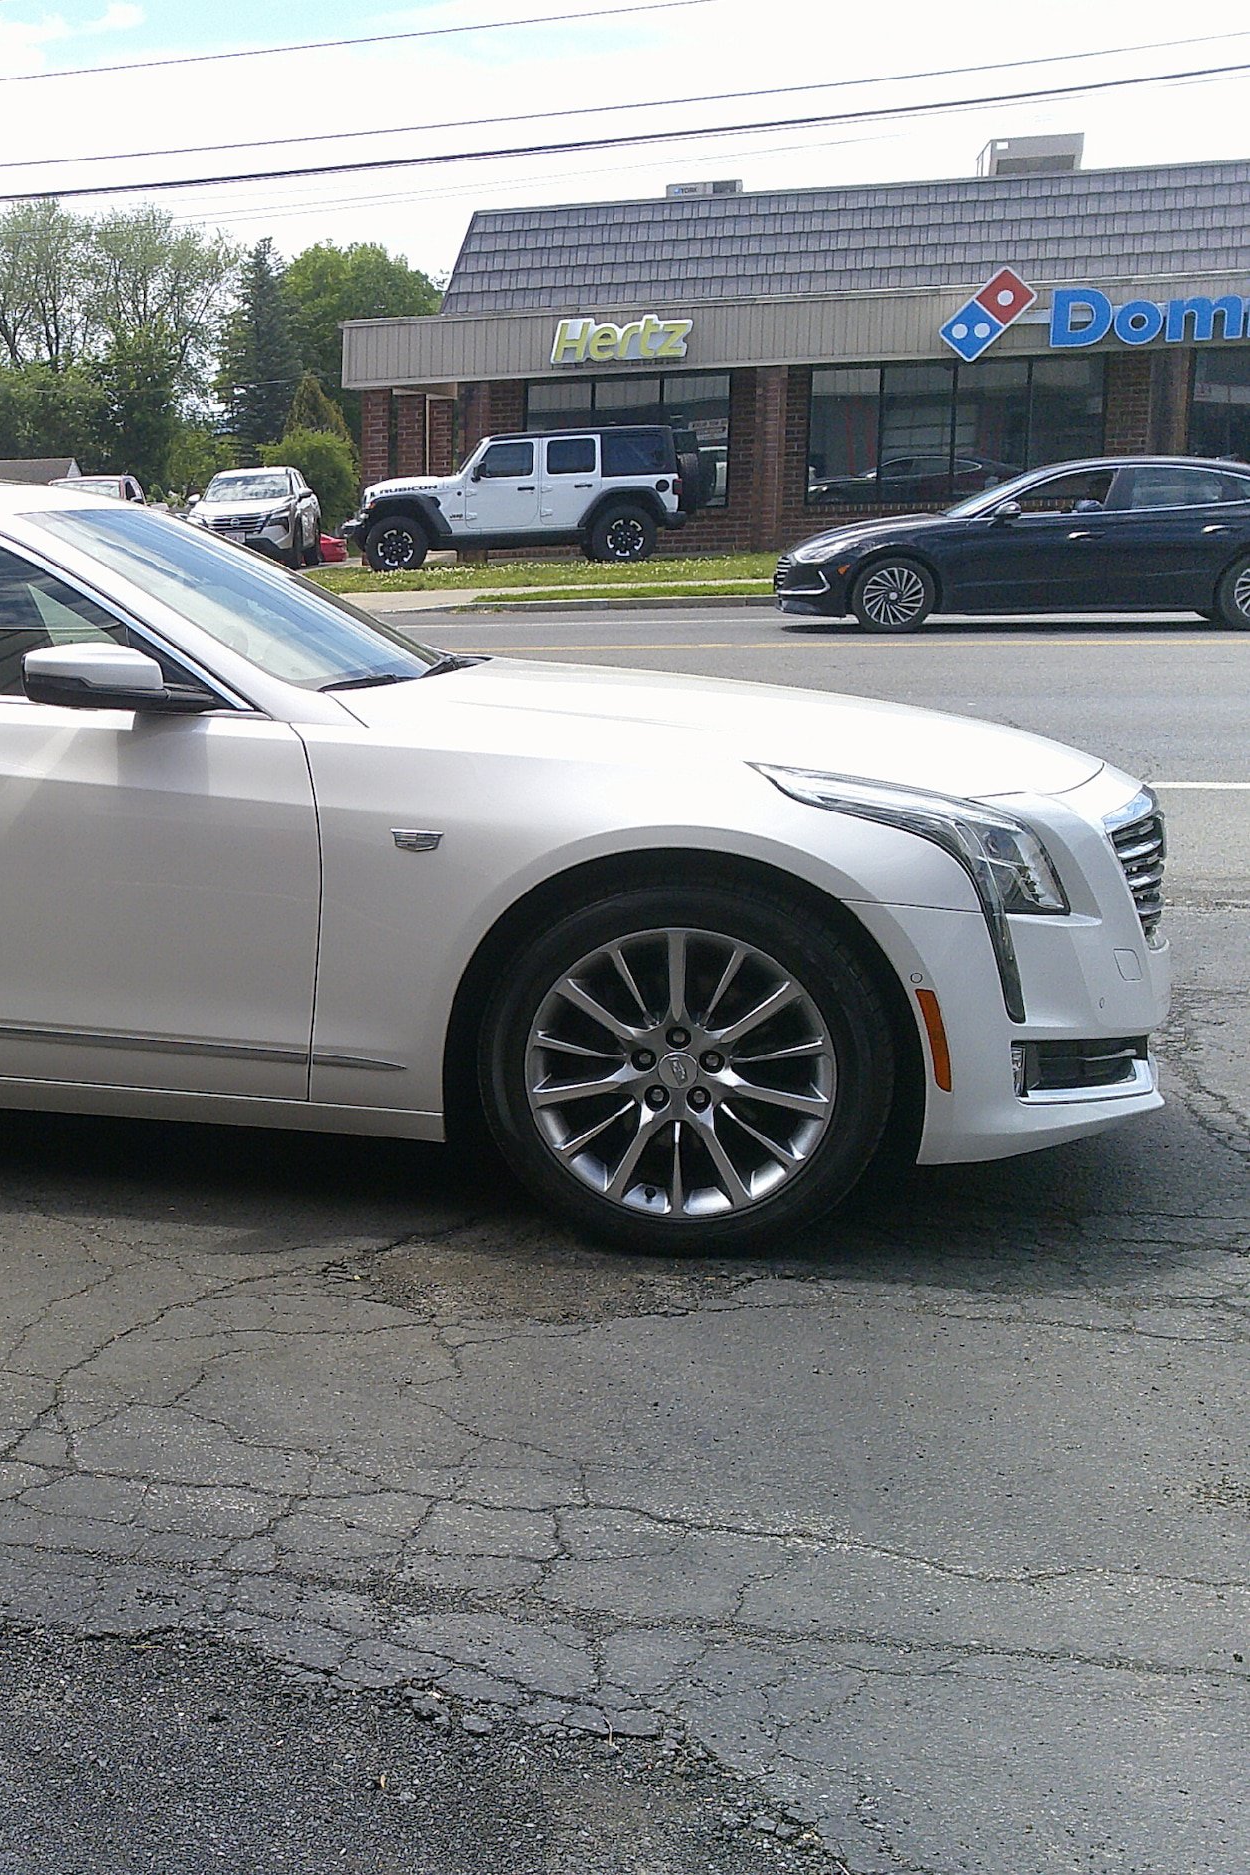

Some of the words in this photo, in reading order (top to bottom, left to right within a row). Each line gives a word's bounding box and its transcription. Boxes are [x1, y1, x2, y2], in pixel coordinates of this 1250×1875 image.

[553, 317, 688, 362] Hertz
[1050, 288, 1250, 348] Dom
[380, 485, 438, 494] RUBICON
